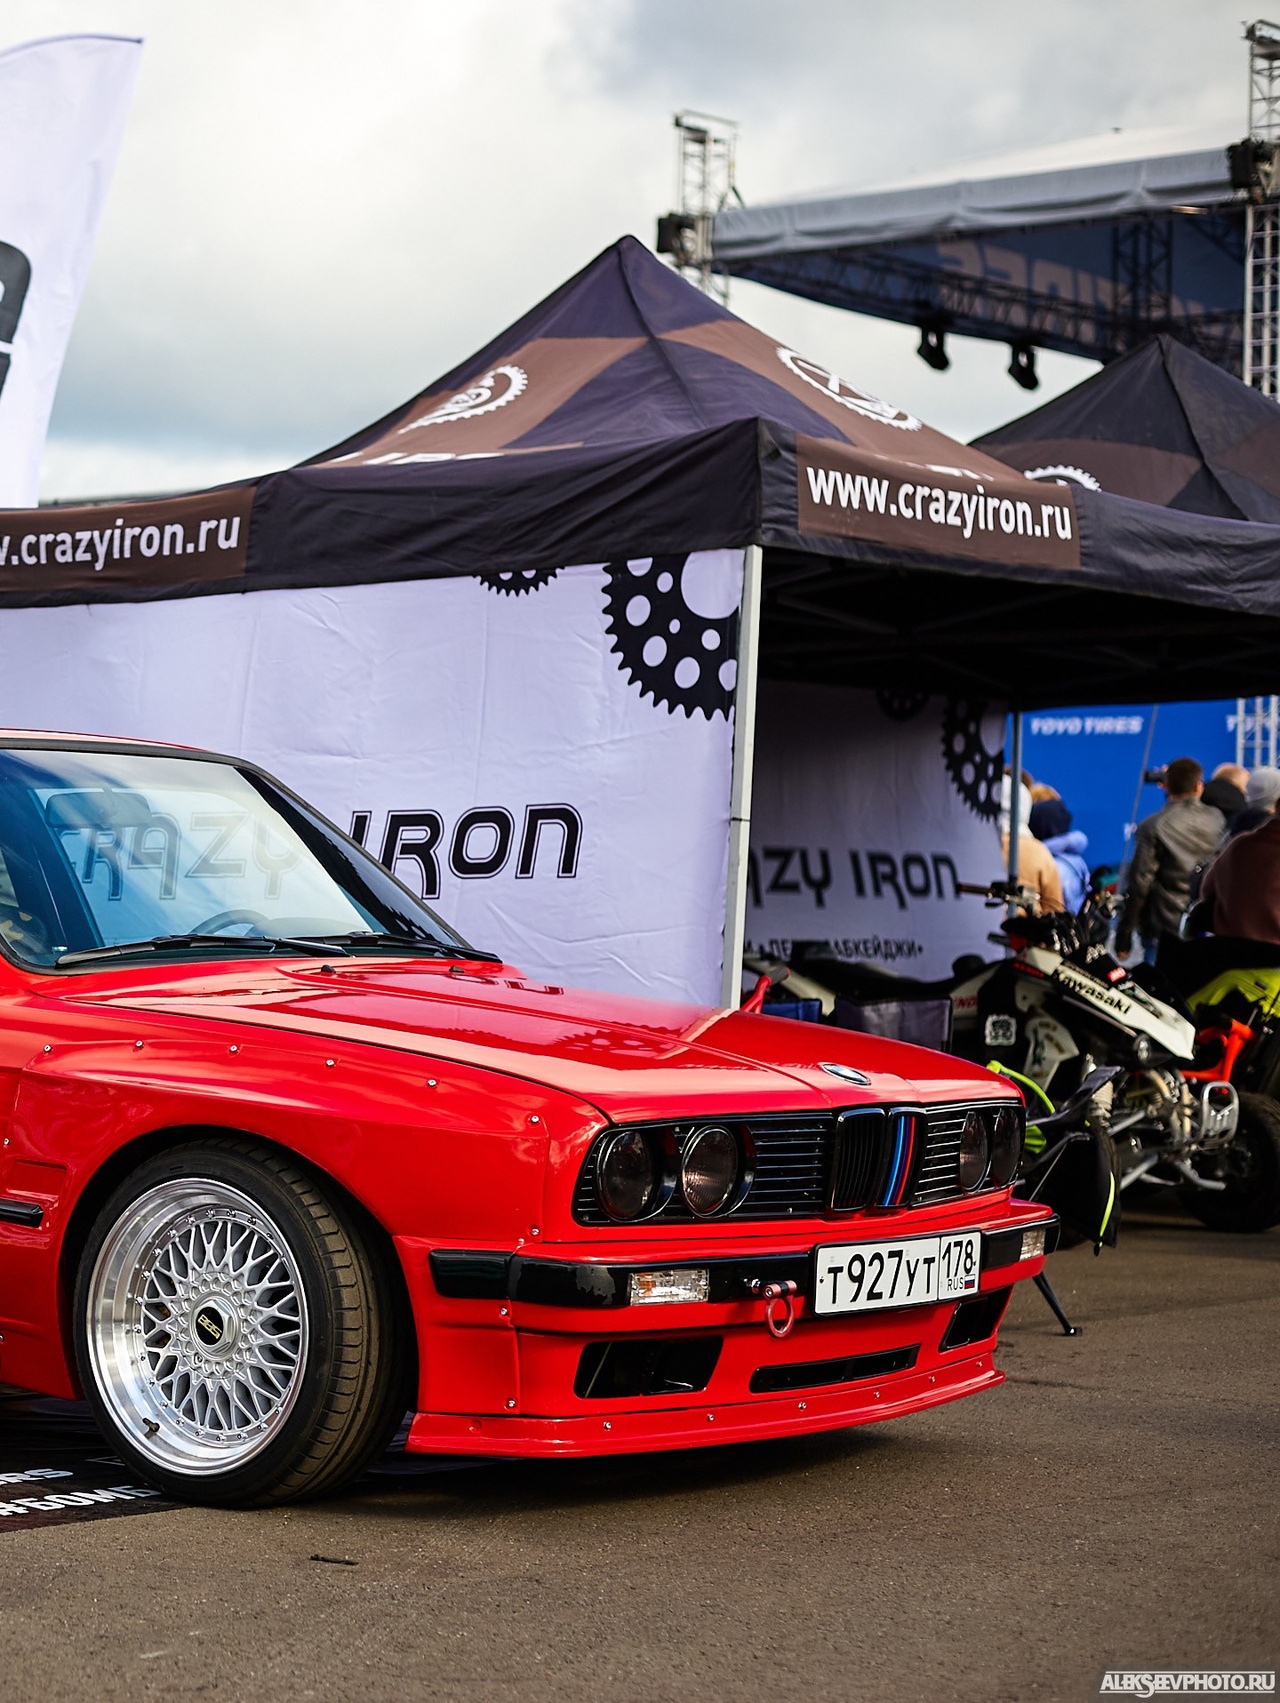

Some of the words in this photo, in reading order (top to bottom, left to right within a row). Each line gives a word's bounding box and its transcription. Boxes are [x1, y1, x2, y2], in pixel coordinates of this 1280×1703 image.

[806, 467, 1071, 540] www.crazyiron.ru
[1031, 716, 1082, 735] TOYO
[1084, 715, 1144, 734] TIRES
[348, 803, 583, 900] IRON
[850, 848, 961, 910] IRON
[1056, 969, 1132, 1015] Kawasaki
[942, 1239, 974, 1279] 178
[947, 1277, 964, 1291] RUS
